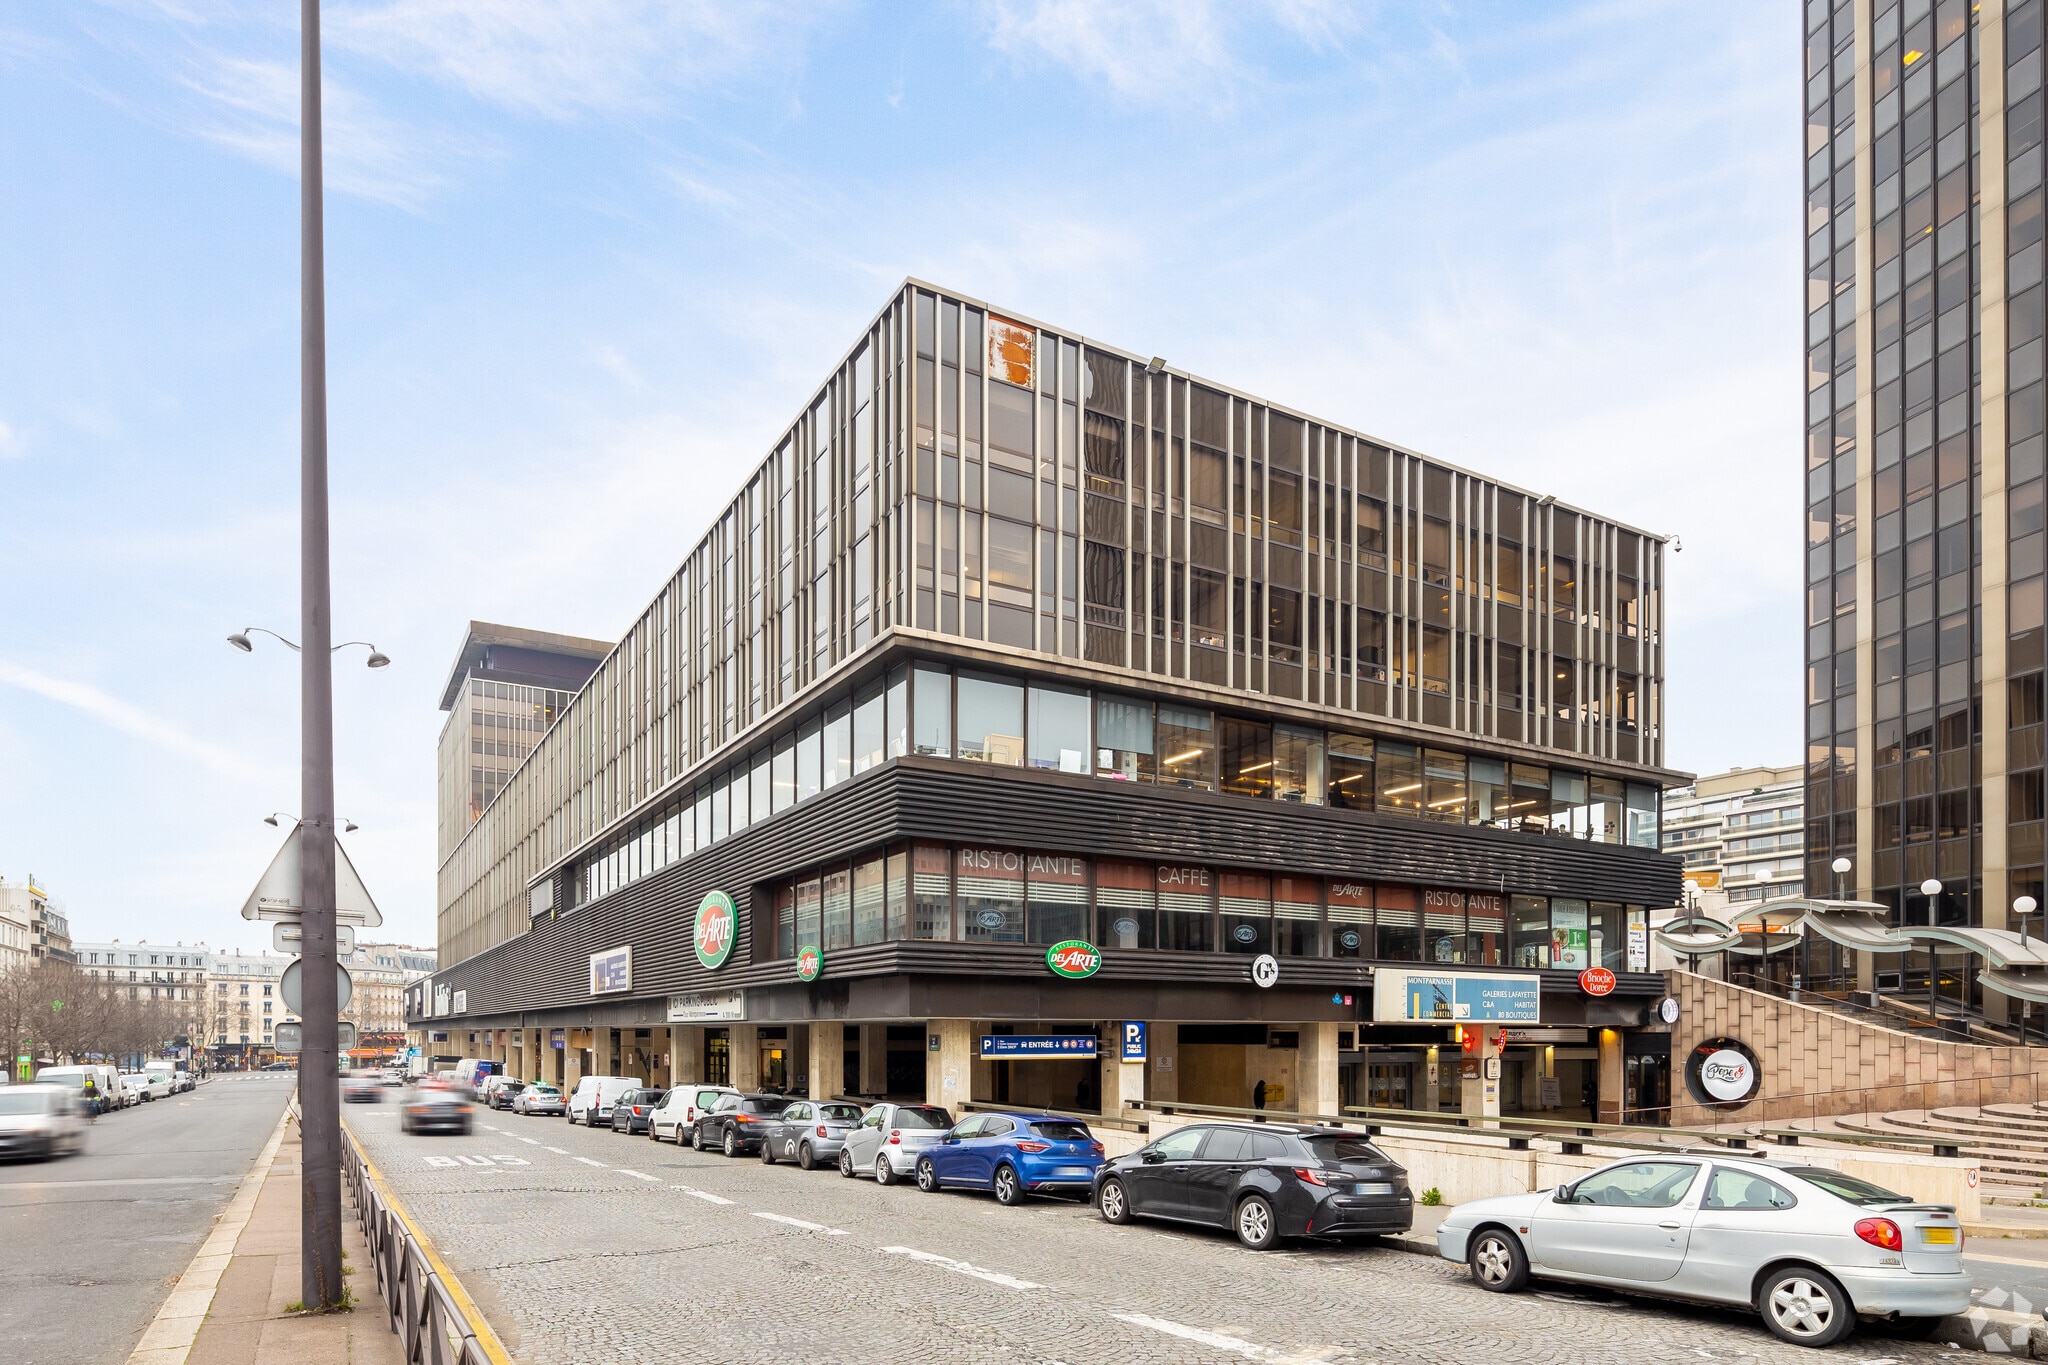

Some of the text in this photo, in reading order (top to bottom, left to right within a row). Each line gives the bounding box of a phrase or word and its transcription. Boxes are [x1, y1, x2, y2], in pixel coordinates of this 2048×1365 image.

[962, 849, 1081, 876] RISTORANTE
[1158, 866, 1209, 887] CAFFÈ
[1425, 890, 1500, 911] RISTORANTE
[1055, 942, 1095, 953] RISTORANTE
[1408, 977, 1453, 986] MONTPARNASSE
[1587, 971, 1612, 983] Brioche
[1482, 990, 1537, 999] GALERIES LAFAYETTE
[1505, 1011, 1537, 1019] BOUTIQUES
[1126, 1024, 1140, 1043] P
[984, 1040, 992, 1050] P
[1028, 1040, 1054, 1048] ENTRÉE
[421, 1155, 532, 1167] BUS
